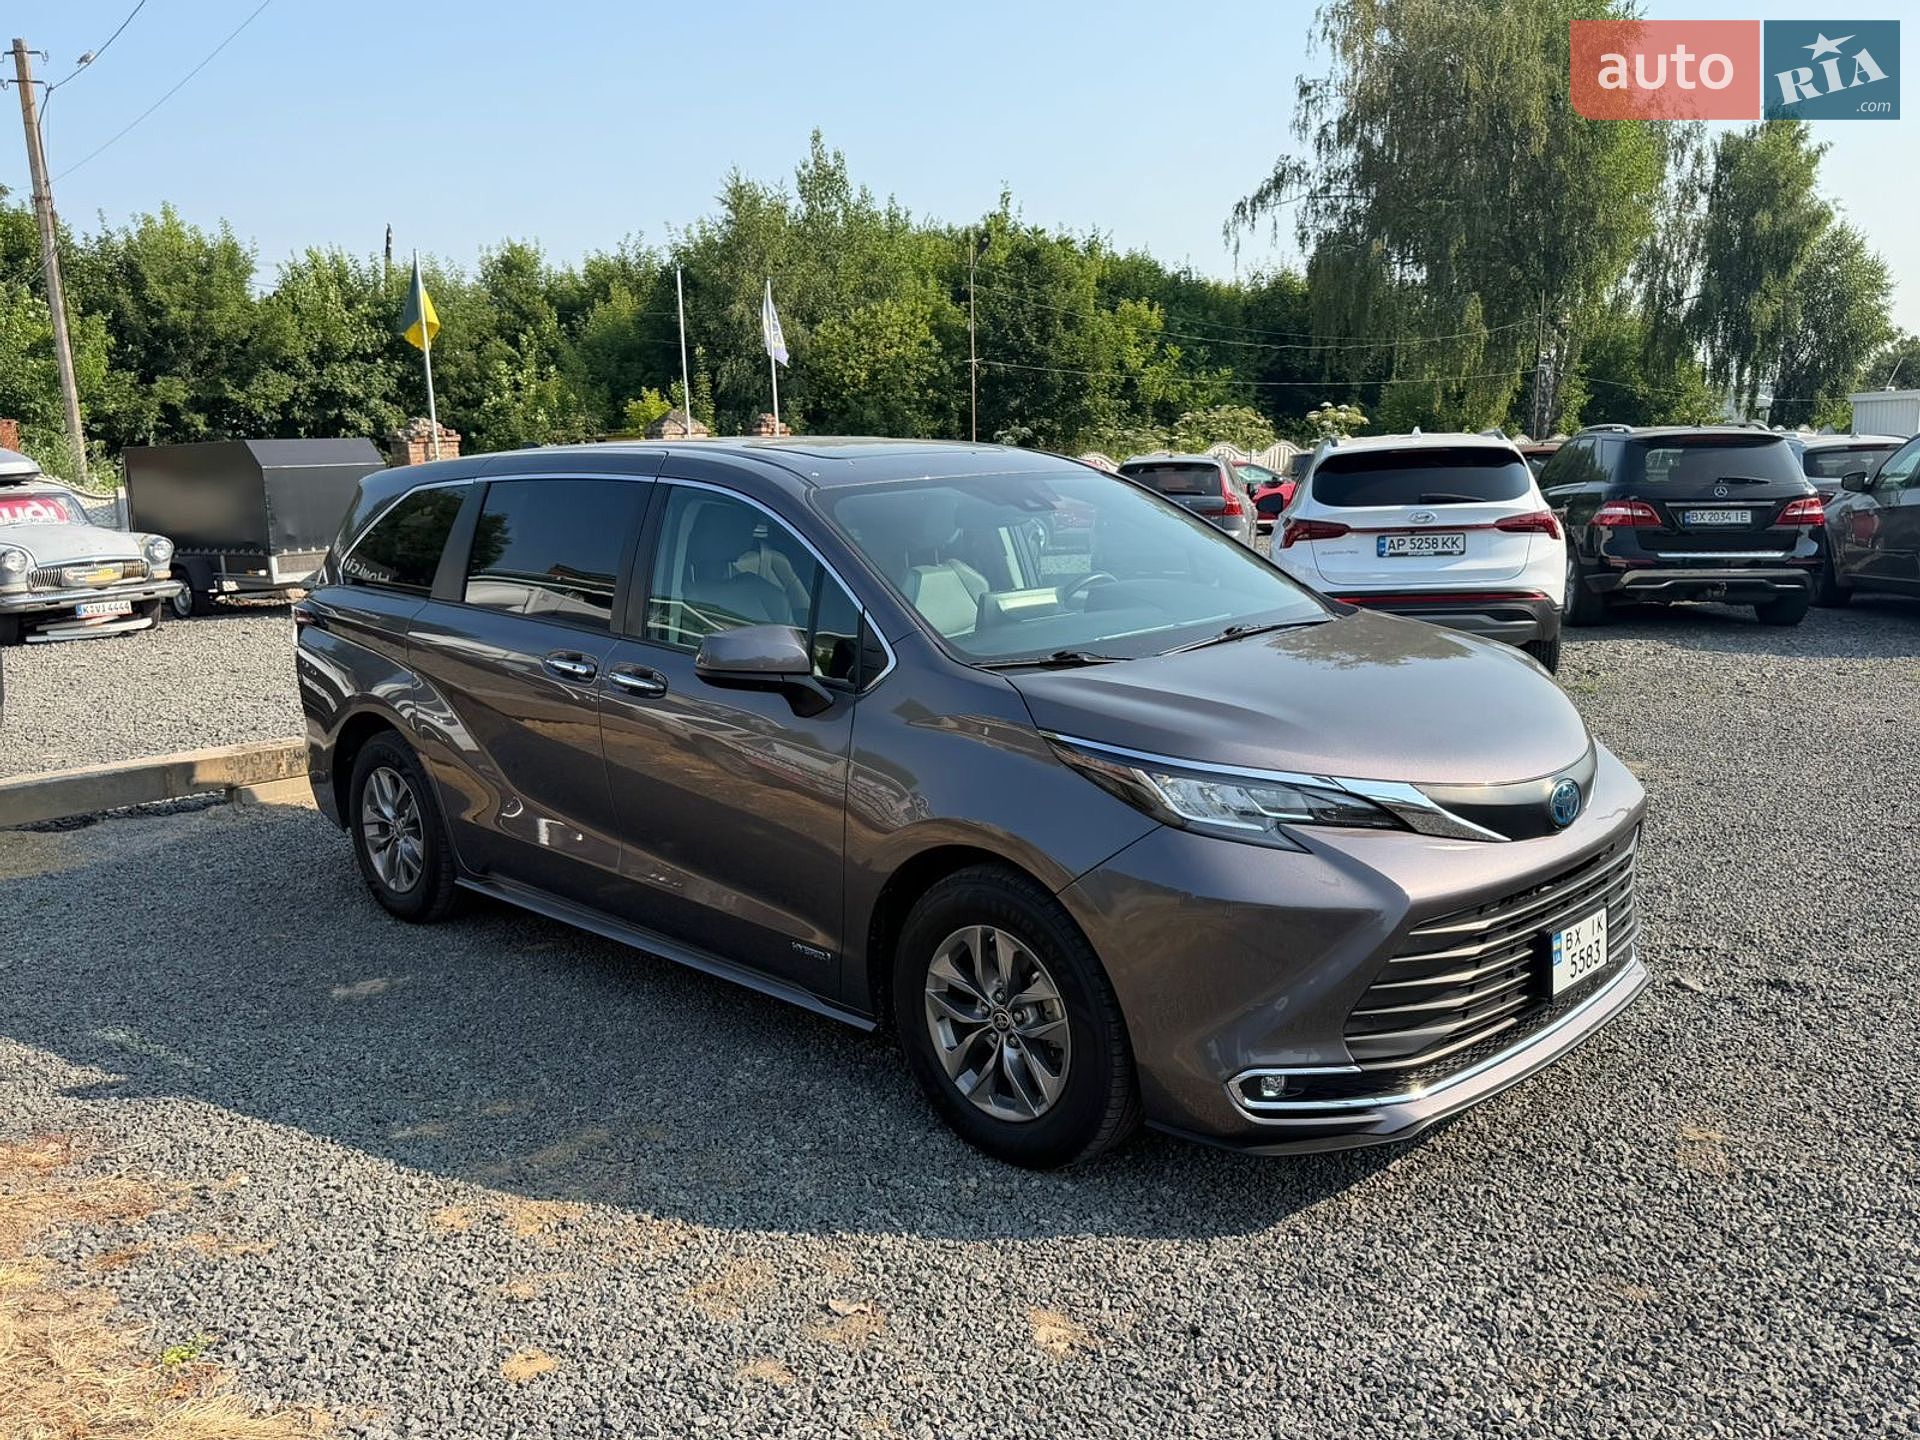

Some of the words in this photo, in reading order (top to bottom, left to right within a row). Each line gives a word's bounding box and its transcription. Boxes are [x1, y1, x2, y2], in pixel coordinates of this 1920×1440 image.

[1691, 512, 1707, 521] BX
[1388, 538, 1406, 550] AP
[1409, 538, 1439, 549] 5258
[1441, 537, 1460, 549] KK
[1566, 928, 1581, 951] BX
[1591, 914, 1603, 936] IK
[1570, 939, 1601, 978] 5583
